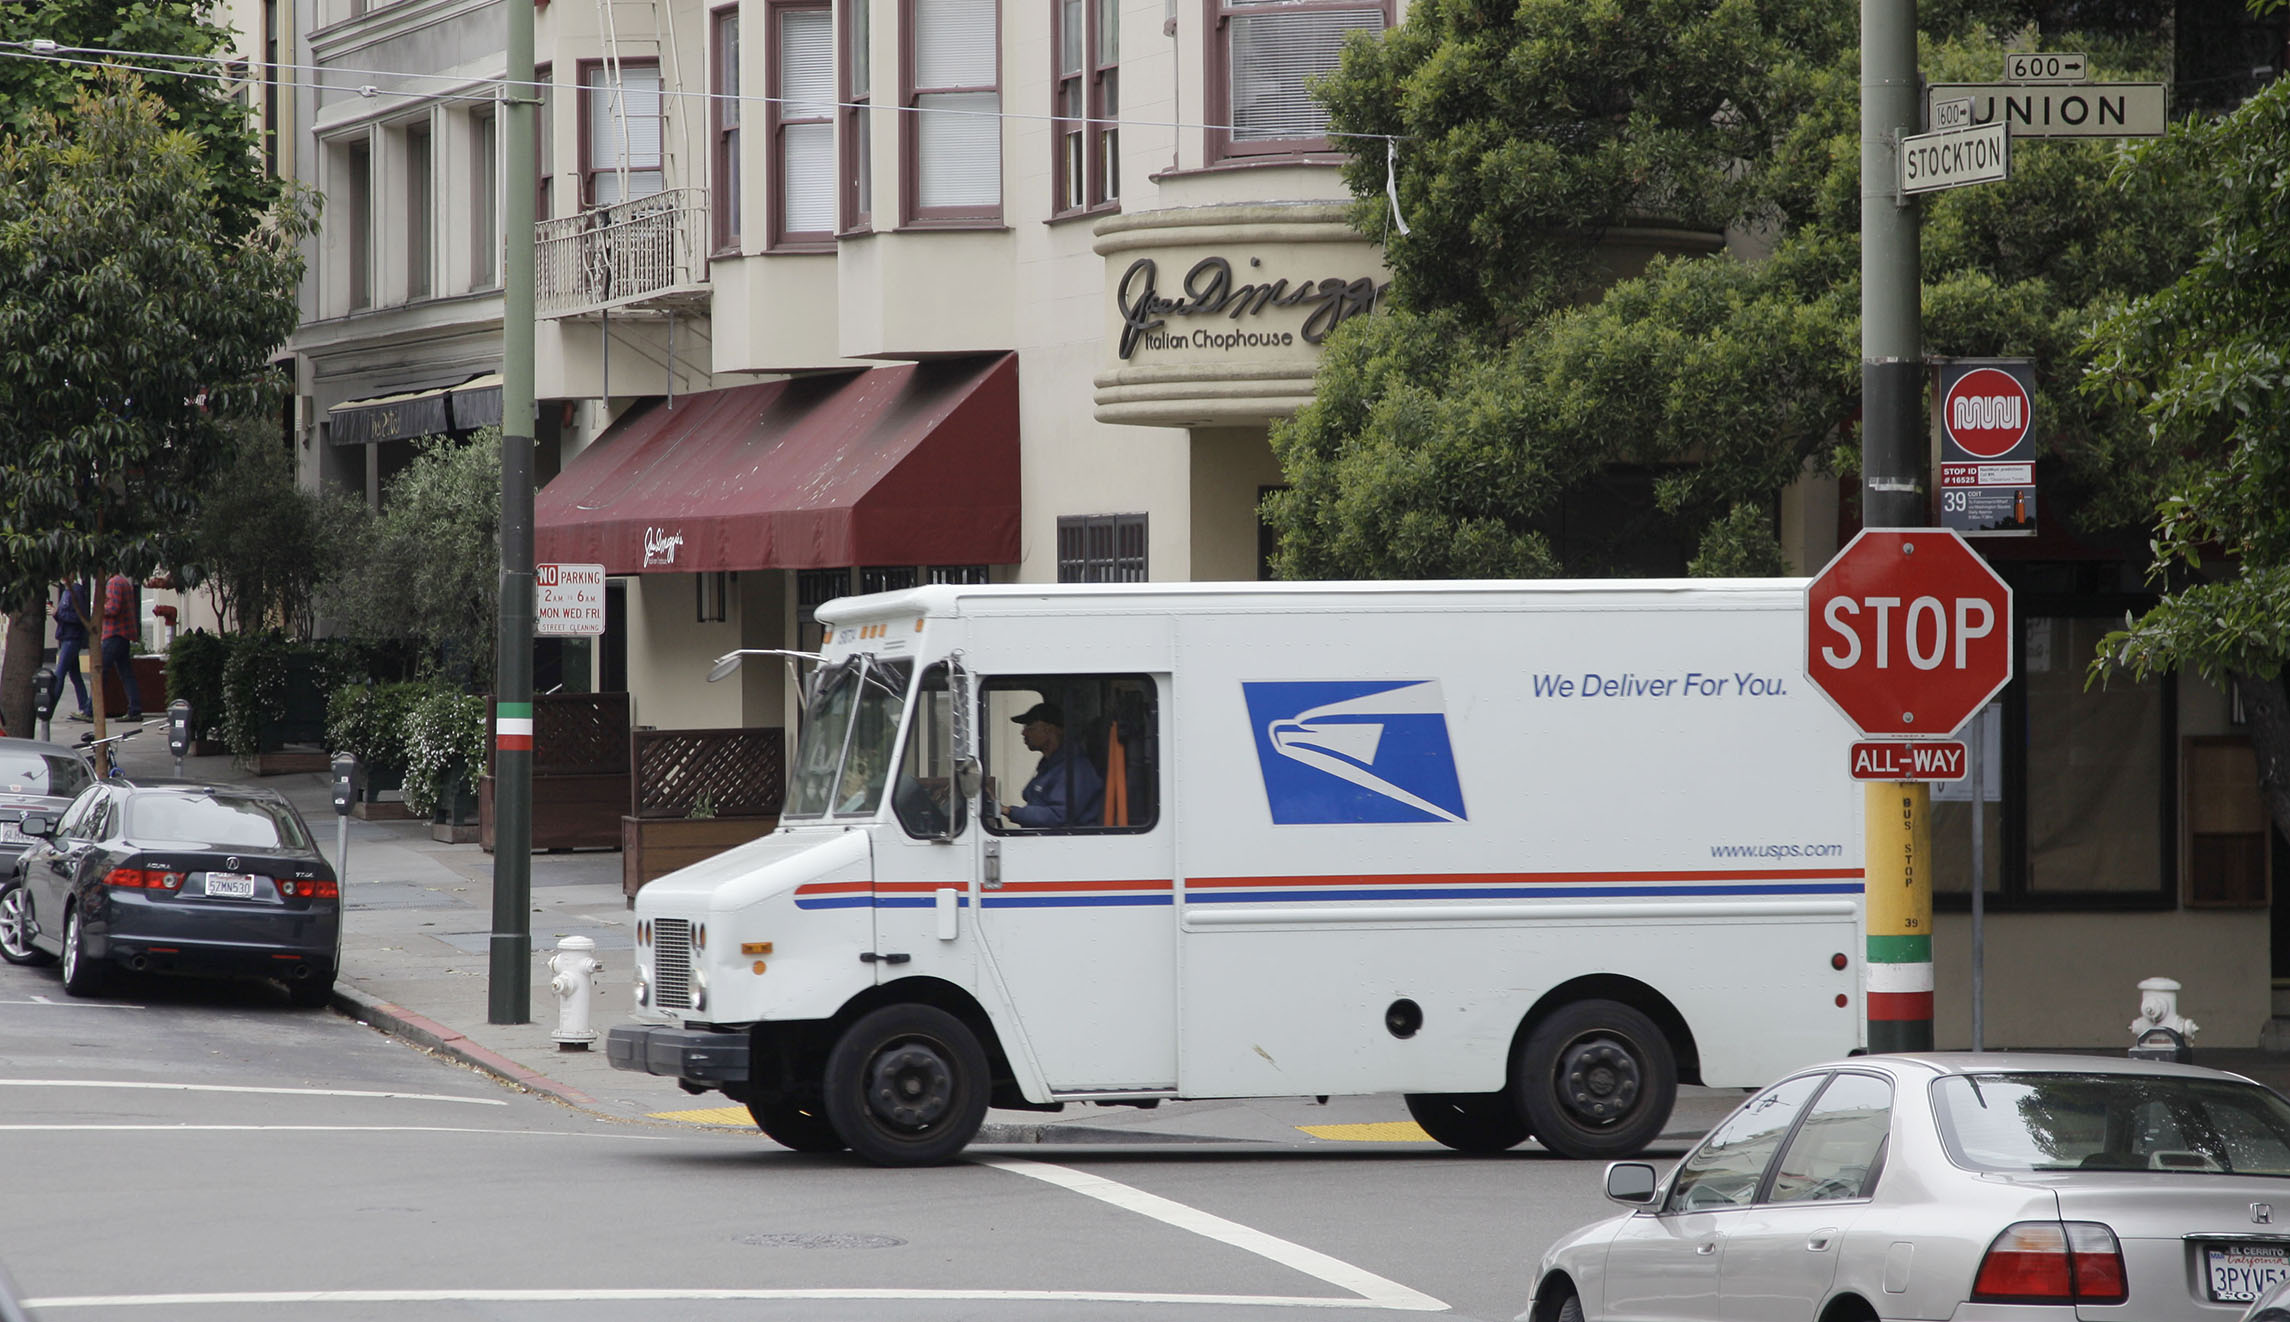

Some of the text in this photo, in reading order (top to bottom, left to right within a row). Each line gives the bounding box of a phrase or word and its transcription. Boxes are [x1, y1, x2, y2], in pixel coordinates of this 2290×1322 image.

[2014, 57, 2060, 77] 600
[1937, 104, 1960, 126] 1600
[1975, 95, 2125, 126] UNION
[1907, 135, 2001, 180] STOCKTON
[1145, 328, 1293, 352] Italian Chophouse
[1953, 395, 2022, 431] MUNI
[1943, 467, 1966, 476] STOP
[1967, 467, 1977, 475] ID
[1951, 476, 1976, 484] 16525
[1943, 491, 1967, 512] 39
[540, 566, 600, 584] NO PARKING
[540, 608, 600, 619] MON WED FRI
[1821, 595, 1996, 671] STOP
[1533, 672, 1788, 698] We Deliver For You.
[1855, 749, 1962, 773] ALL-WAY
[1903, 797, 1912, 831] BUS
[1710, 843, 1843, 861] www.usps.com
[1904, 843, 1913, 888] STOP
[209, 880, 250, 893] 5ZMN530
[1904, 918, 1919, 928] 39
[2227, 1254, 2289, 1268] California
[2230, 1246, 2285, 1257] EL CERRITO
